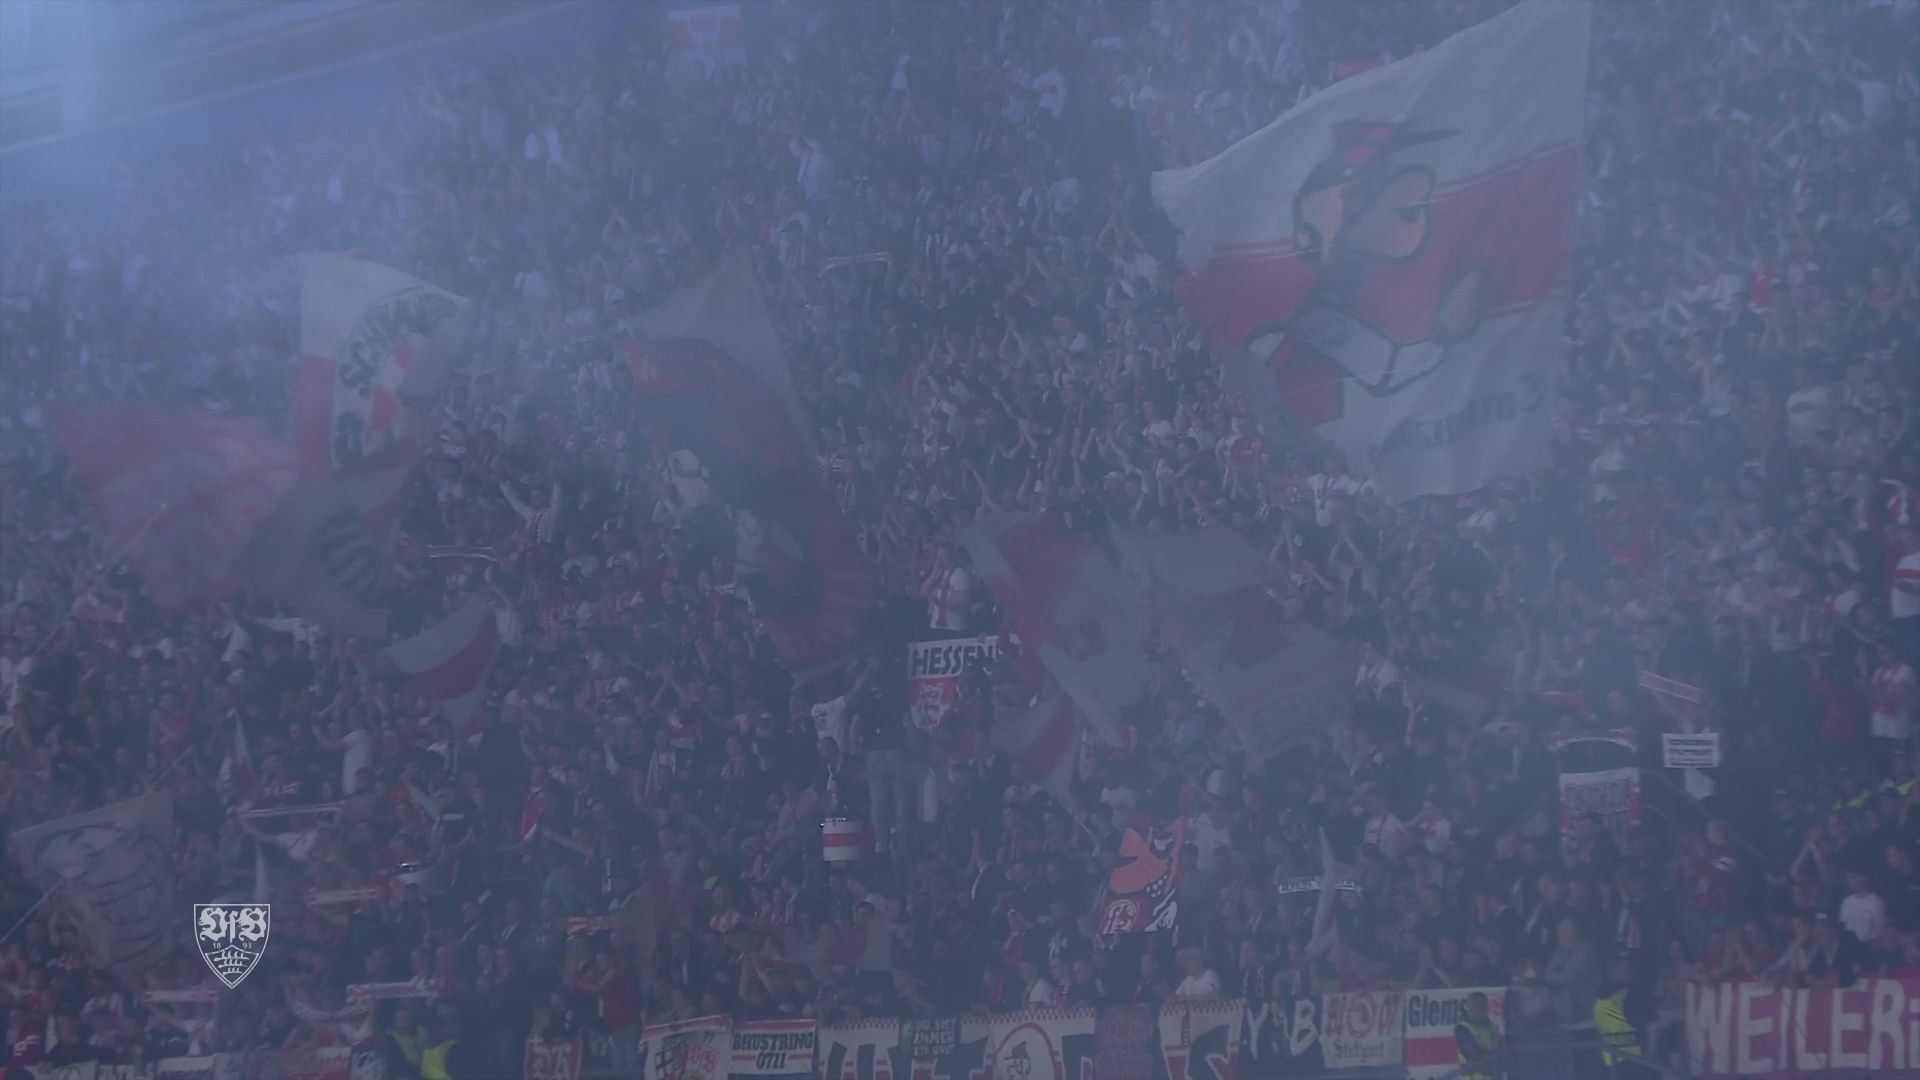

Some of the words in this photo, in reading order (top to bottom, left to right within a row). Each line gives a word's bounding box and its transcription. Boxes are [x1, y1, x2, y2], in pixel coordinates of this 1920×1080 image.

[911, 645, 994, 676] HESSEN
[732, 1031, 813, 1051] BRUSTRING
[756, 1052, 785, 1070] 0711
